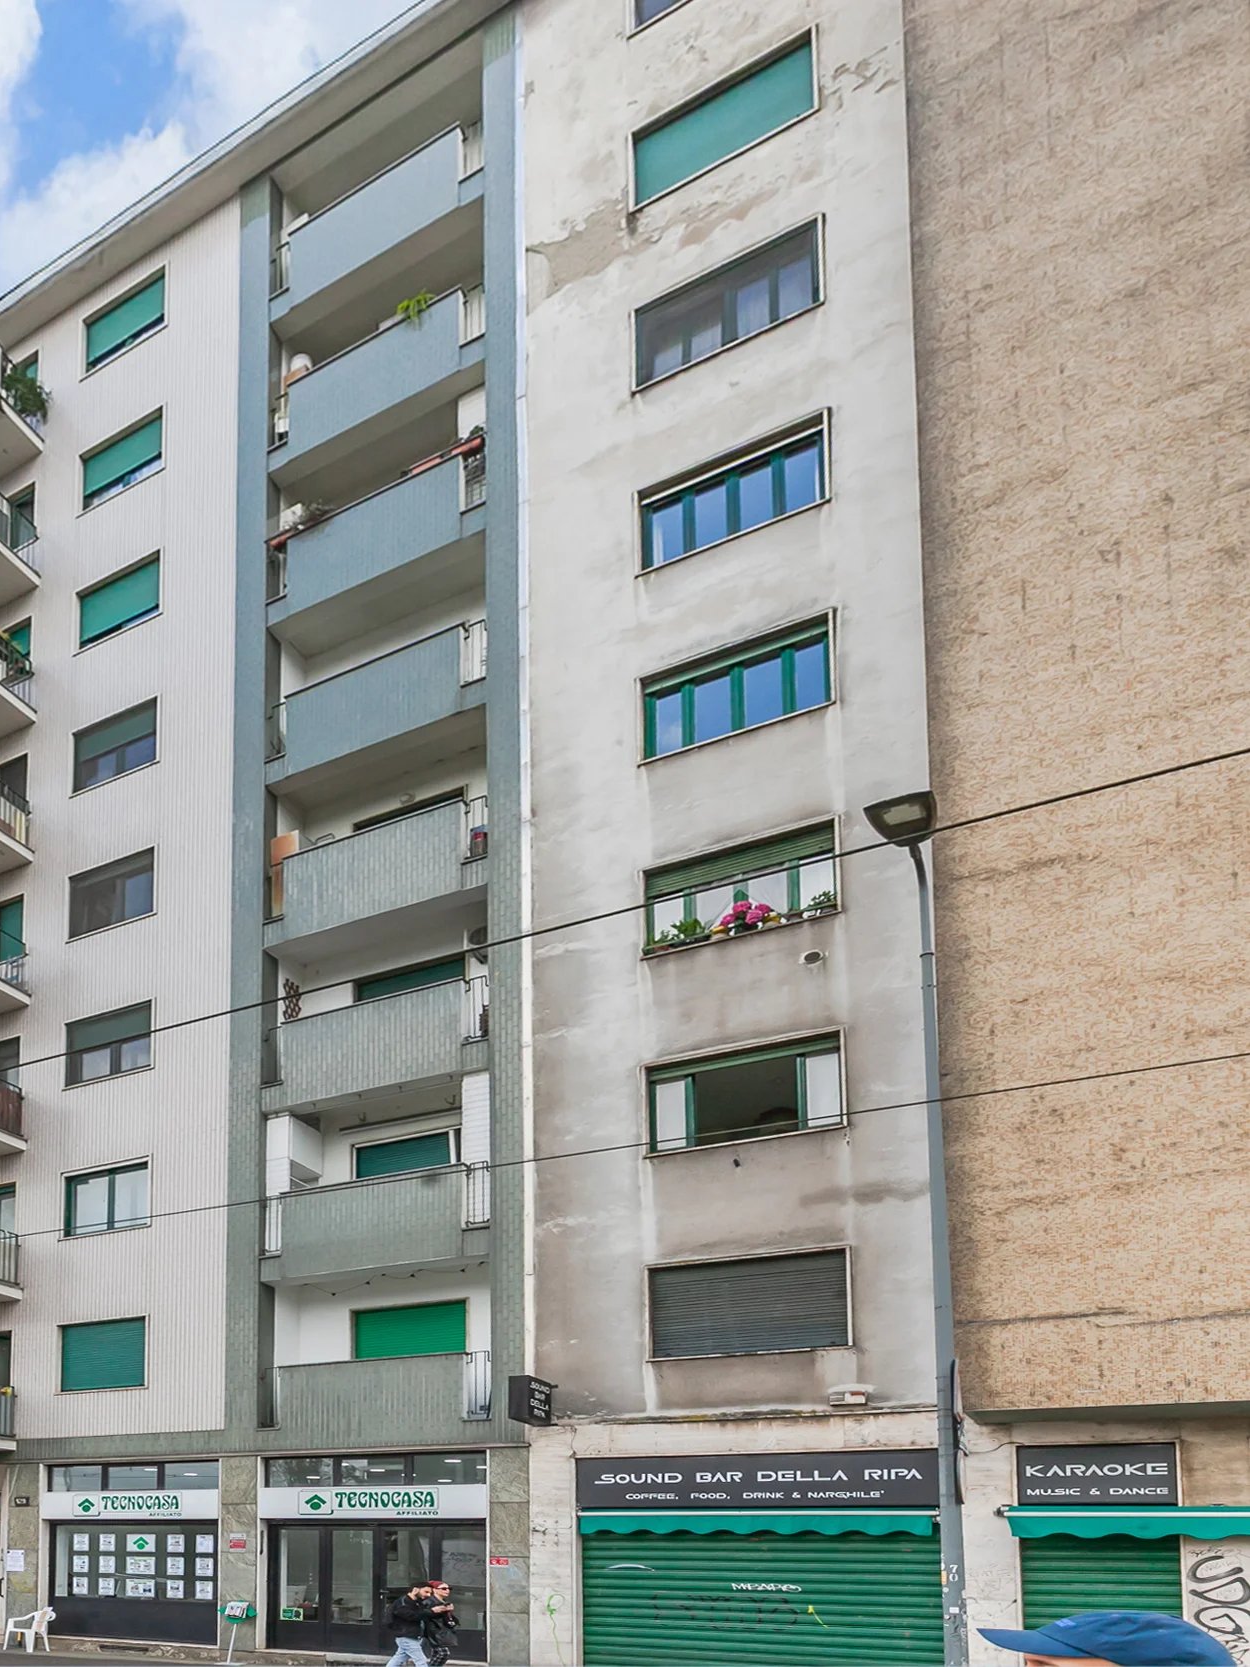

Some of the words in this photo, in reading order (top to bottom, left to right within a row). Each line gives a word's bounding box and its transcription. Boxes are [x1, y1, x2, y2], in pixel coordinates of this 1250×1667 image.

[530, 1381, 550, 1394] SOUND
[534, 1391, 546, 1401] BAR
[530, 1398, 549, 1411] DELLA
[594, 1472, 683, 1485] SOUND
[695, 1471, 743, 1483] BAR
[757, 1469, 849, 1482] DELLA
[863, 1468, 923, 1481] RIPA
[1025, 1462, 1168, 1478] KARAOKE
[742, 1491, 785, 1499] DRINK
[792, 1491, 801, 1499] &
[1026, 1488, 1081, 1496] MUSIC
[1109, 1487, 1169, 1495] DANCE
[101, 1494, 179, 1511] TECNOCASA
[334, 1490, 436, 1508] TECNOCASA
